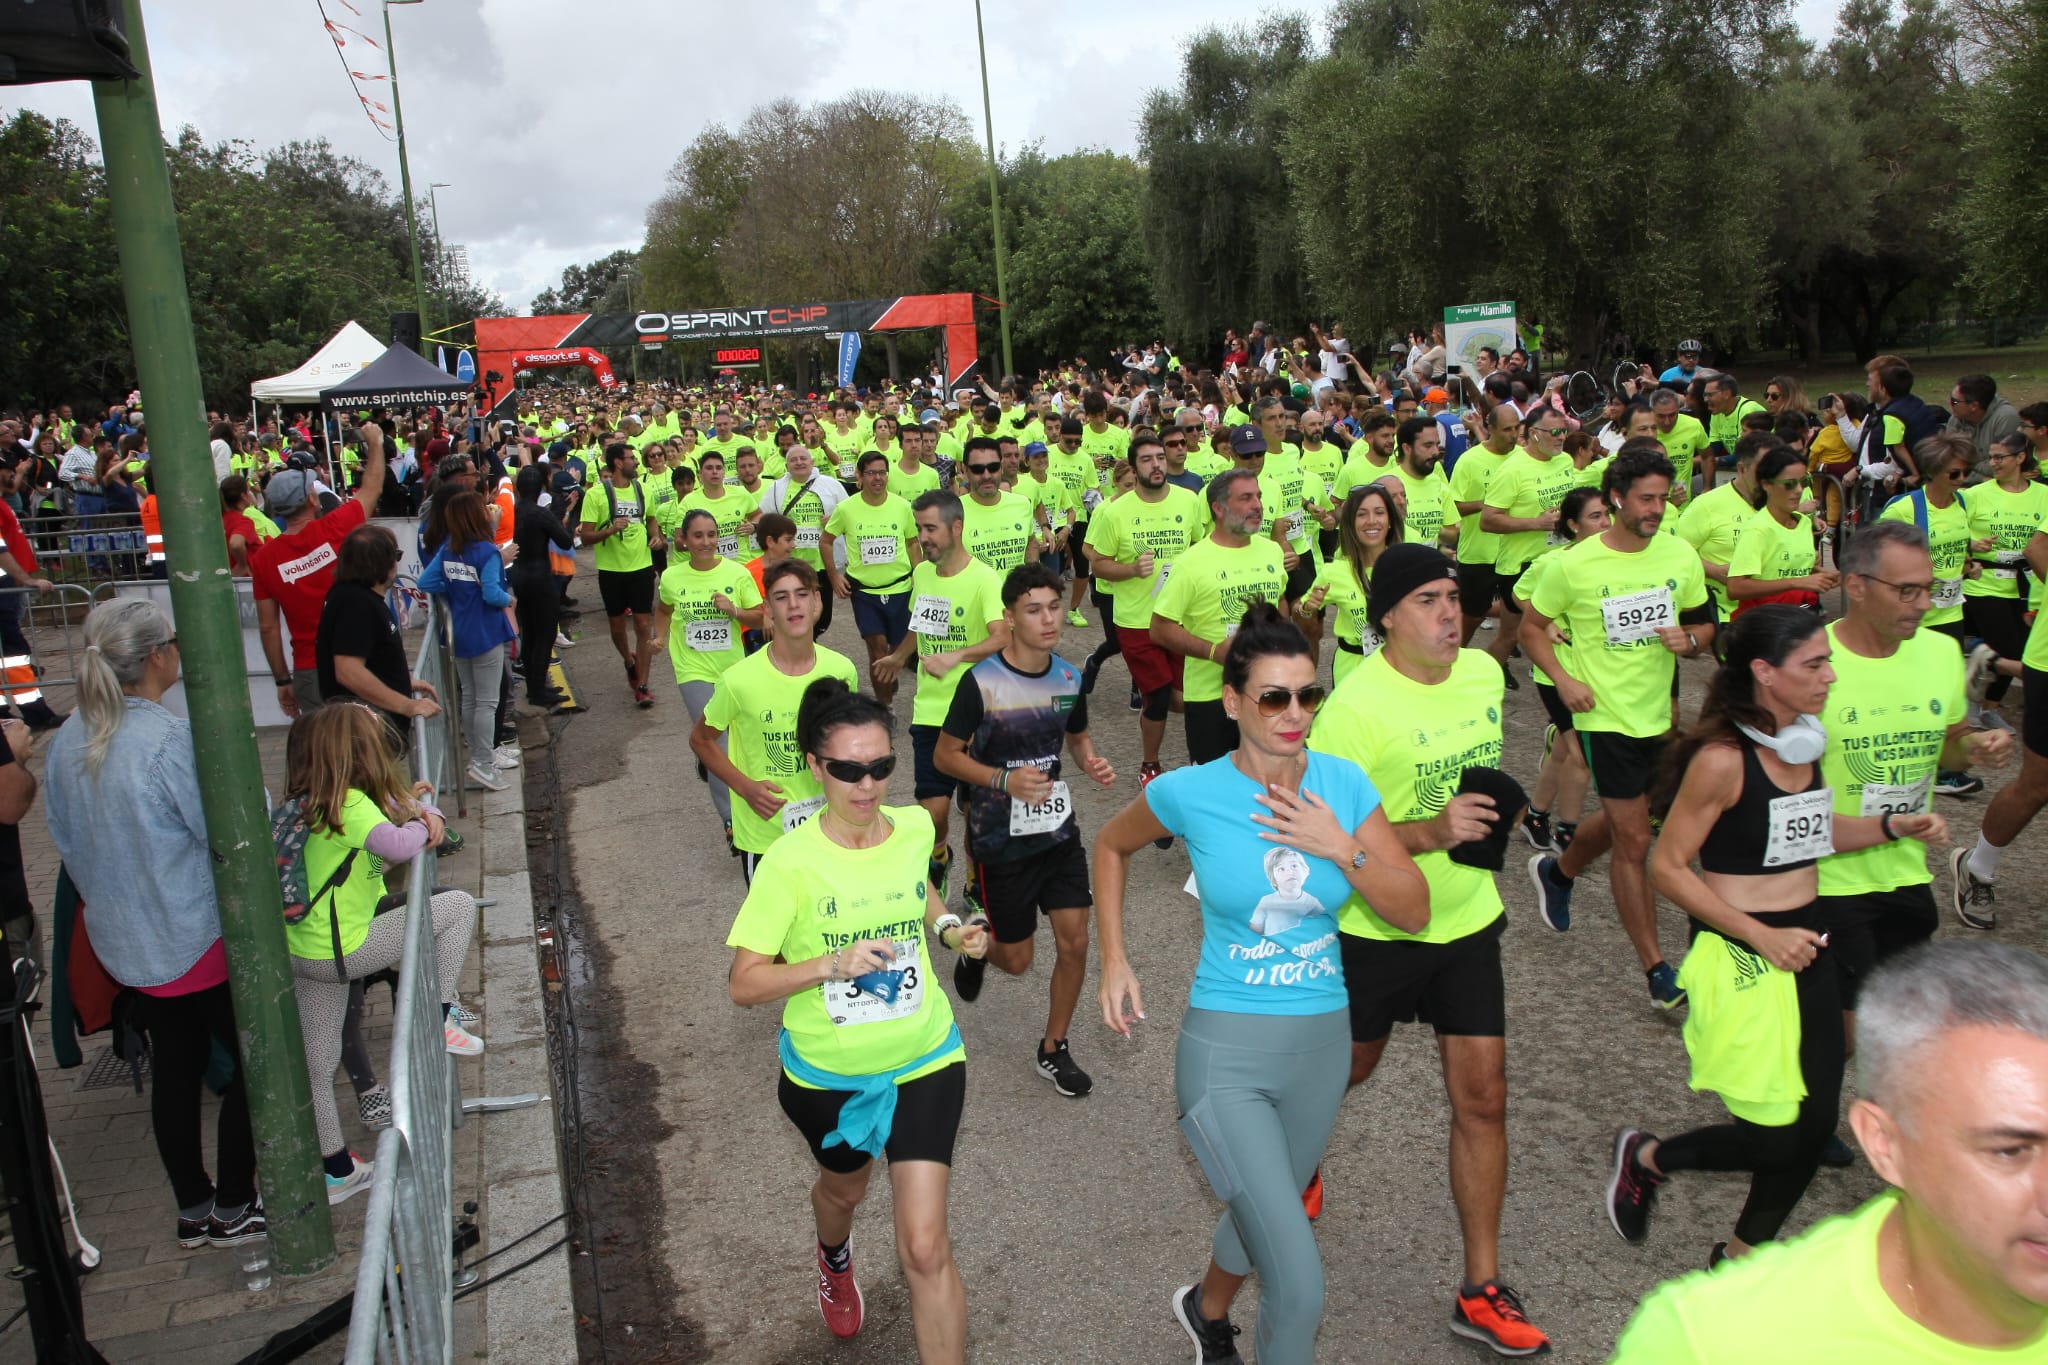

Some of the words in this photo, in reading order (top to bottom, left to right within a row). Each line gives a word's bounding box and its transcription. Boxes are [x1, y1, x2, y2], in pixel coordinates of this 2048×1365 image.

[1480, 304, 1512, 316] Alamillo
[332, 390, 468, 407] www.sprintchip.es
[797, 533, 820, 541] 4938
[868, 546, 894, 555] 4023
[972, 544, 985, 552] TUS
[1154, 548, 1163, 559] XI
[284, 550, 330, 576] voluntario
[996, 558, 1006, 570] XI
[1220, 588, 1236, 597] TUS
[920, 608, 950, 624] 4822
[1618, 604, 1668, 627] 5922
[694, 628, 728, 641] 4823
[762, 732, 782, 741] TUS
[1842, 736, 1870, 750] TUS
[1874, 748, 1896, 762] NOS
[1899, 746, 1920, 760] DAN
[1416, 760, 1440, 777] TUS
[1442, 766, 1460, 782] NOS
[1888, 764, 1906, 786] XI
[1022, 798, 1066, 818] 1458
[822, 932, 850, 948] TUS
[1228, 938, 1286, 960] Todos
